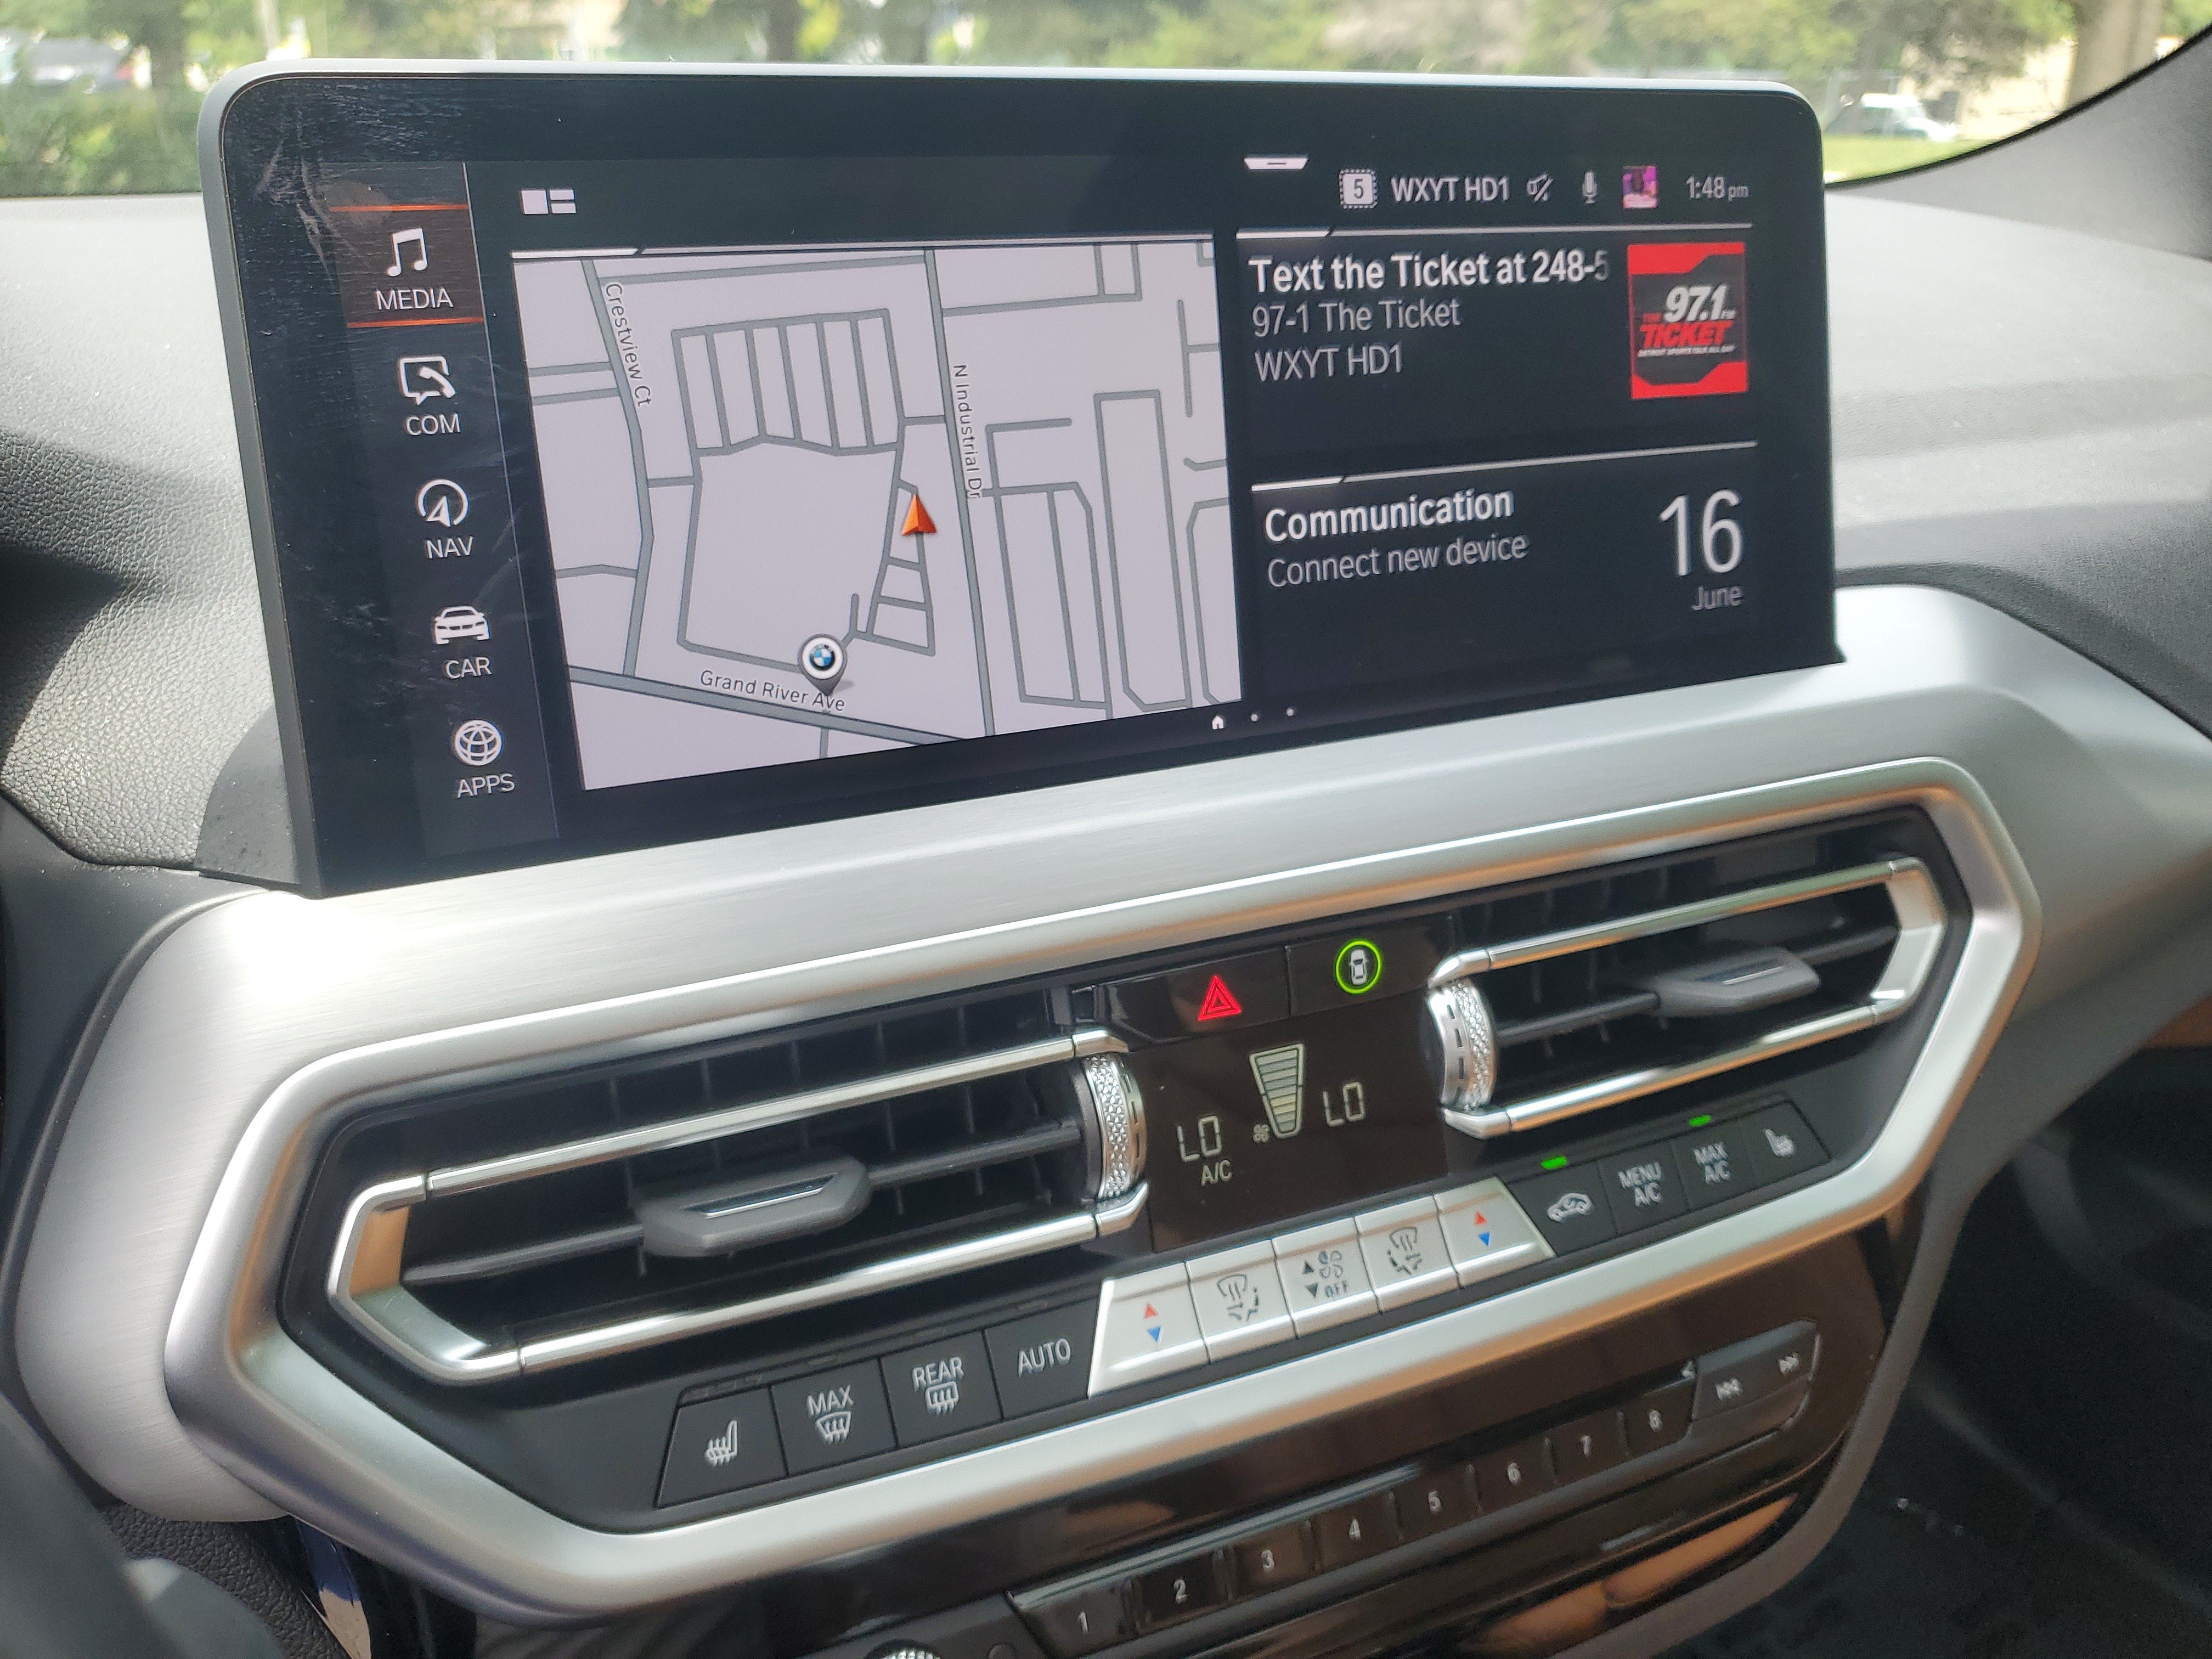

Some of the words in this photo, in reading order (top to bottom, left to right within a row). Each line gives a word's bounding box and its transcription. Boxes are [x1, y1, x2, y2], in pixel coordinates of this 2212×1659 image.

[1353, 178, 1364, 199] 5
[1391, 177, 1459, 202] WXYT
[1464, 176, 1510, 201] HD1
[1686, 176, 1724, 199] 1:48
[1728, 186, 1749, 201] pm
[1249, 257, 1324, 292] Text
[1331, 258, 1384, 289] the
[1391, 253, 1489, 286] Ticket
[1496, 255, 1526, 284] at
[375, 288, 453, 309] MEDIA
[1664, 283, 1728, 322] 97.1
[1252, 303, 1310, 336] 97-1
[1319, 302, 1372, 331] The
[1379, 298, 1461, 329] Ticket
[606, 284, 642, 380] Crestview
[634, 385, 651, 407] Ct
[1640, 320, 1734, 348] TICKET
[953, 365, 968, 377] N
[1255, 346, 1340, 381] WXYT
[1348, 342, 1402, 375] HD1
[406, 414, 461, 435] COM
[956, 385, 979, 471] Industrial
[967, 478, 982, 498] Dr
[1265, 488, 1514, 541] Communication
[1660, 490, 1742, 577] 16
[425, 537, 473, 558] NAV
[1268, 549, 1380, 588] Connect
[1388, 545, 1438, 572] new
[1447, 533, 1529, 566] device
[1692, 585, 1742, 611] June
[445, 657, 492, 679] CAR
[701, 670, 757, 695] Grand
[763, 682, 809, 704] River
[812, 692, 845, 711] Ave
[457, 774, 515, 797] APPS
[1693, 1142, 1728, 1164] MAX
[1201, 1160, 1232, 1186] A/C
[1617, 1162, 1663, 1189] MENU
[1705, 1160, 1731, 1184] A/C
[1634, 1182, 1662, 1207] A/C
[1018, 1339, 1071, 1377] AUTO
[912, 1357, 964, 1389] REAR
[807, 1385, 854, 1415] MAX
[1649, 1409, 1662, 1432] 8
[1581, 1435, 1591, 1457] 7
[1508, 1462, 1521, 1485] 6
[1429, 1491, 1441, 1513] 5
[1349, 1518, 1361, 1540] 4
[1262, 1549, 1275, 1573] 3
[1173, 1578, 1188, 1604] 2
[1078, 1610, 1088, 1633] 1
